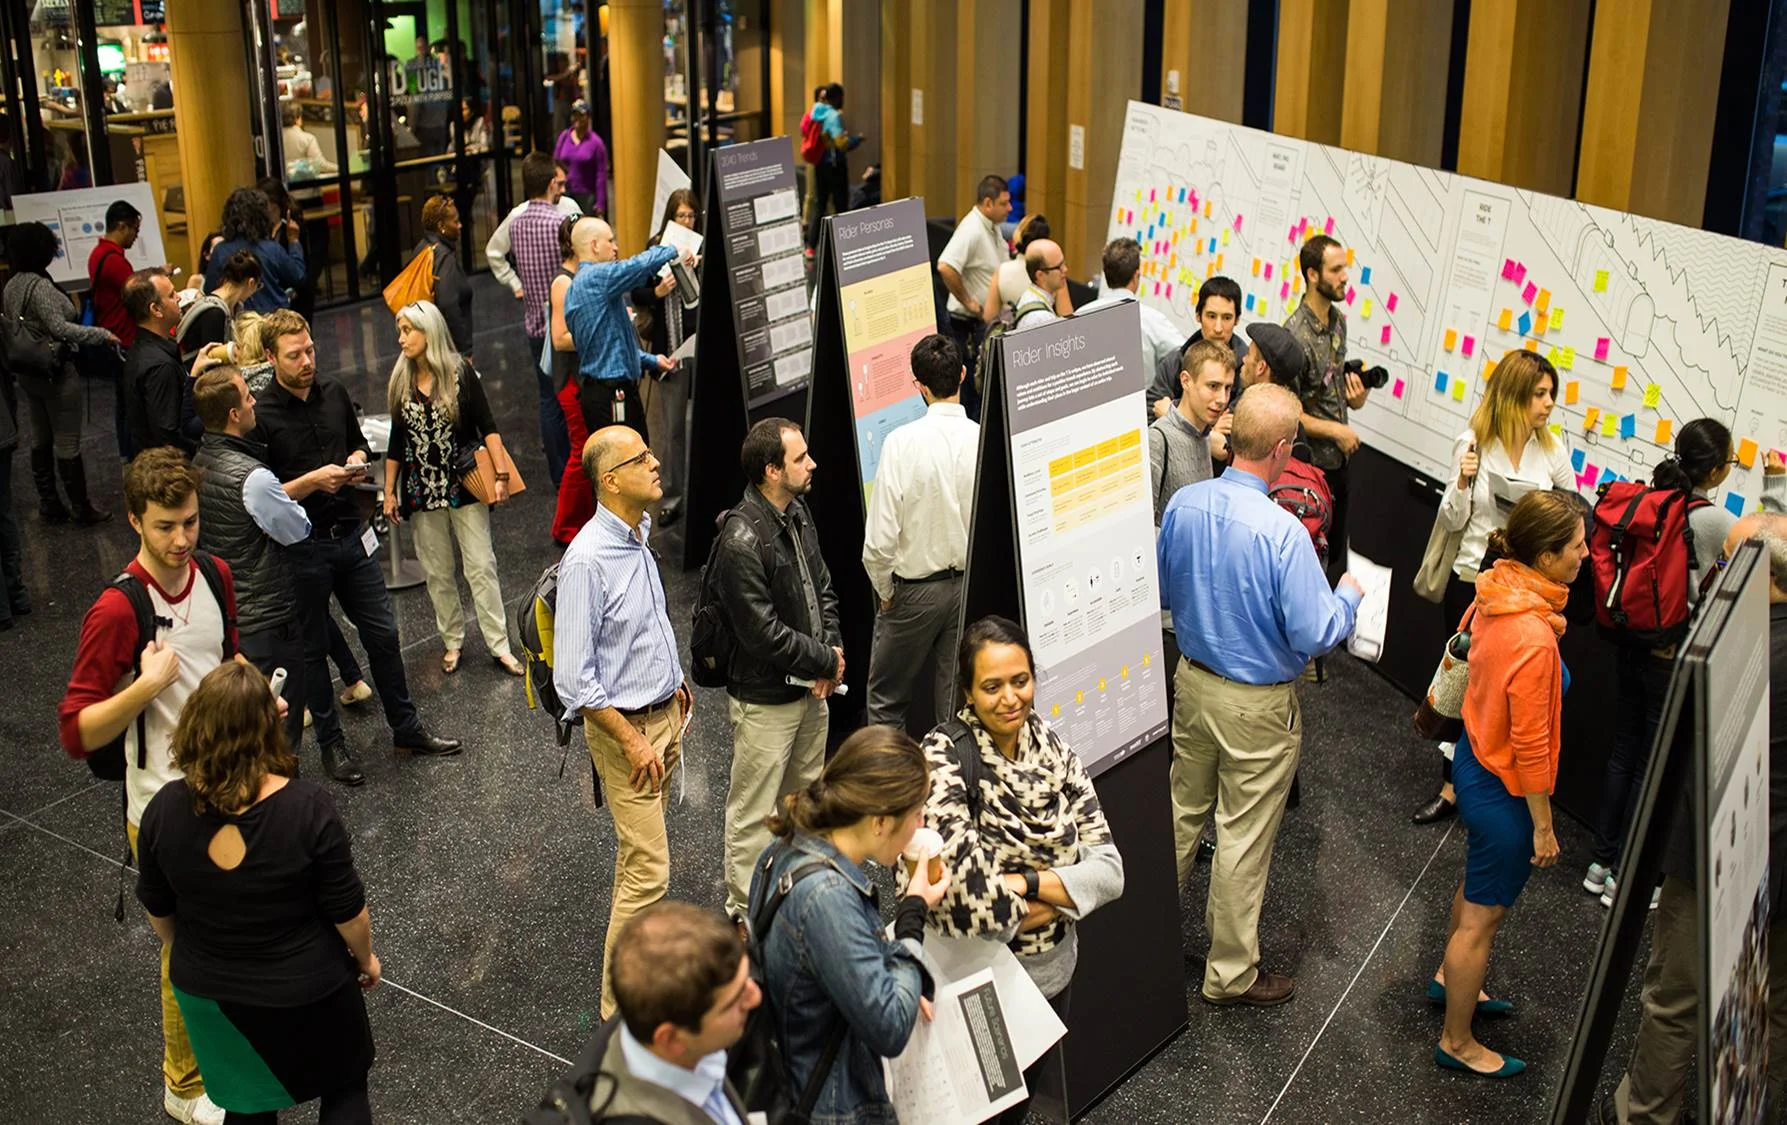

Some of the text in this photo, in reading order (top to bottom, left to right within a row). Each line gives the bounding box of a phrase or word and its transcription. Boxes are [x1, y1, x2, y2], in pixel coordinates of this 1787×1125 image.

[838, 218, 895, 240] Rider Personas
[1012, 335, 1086, 369] Rider Insights
